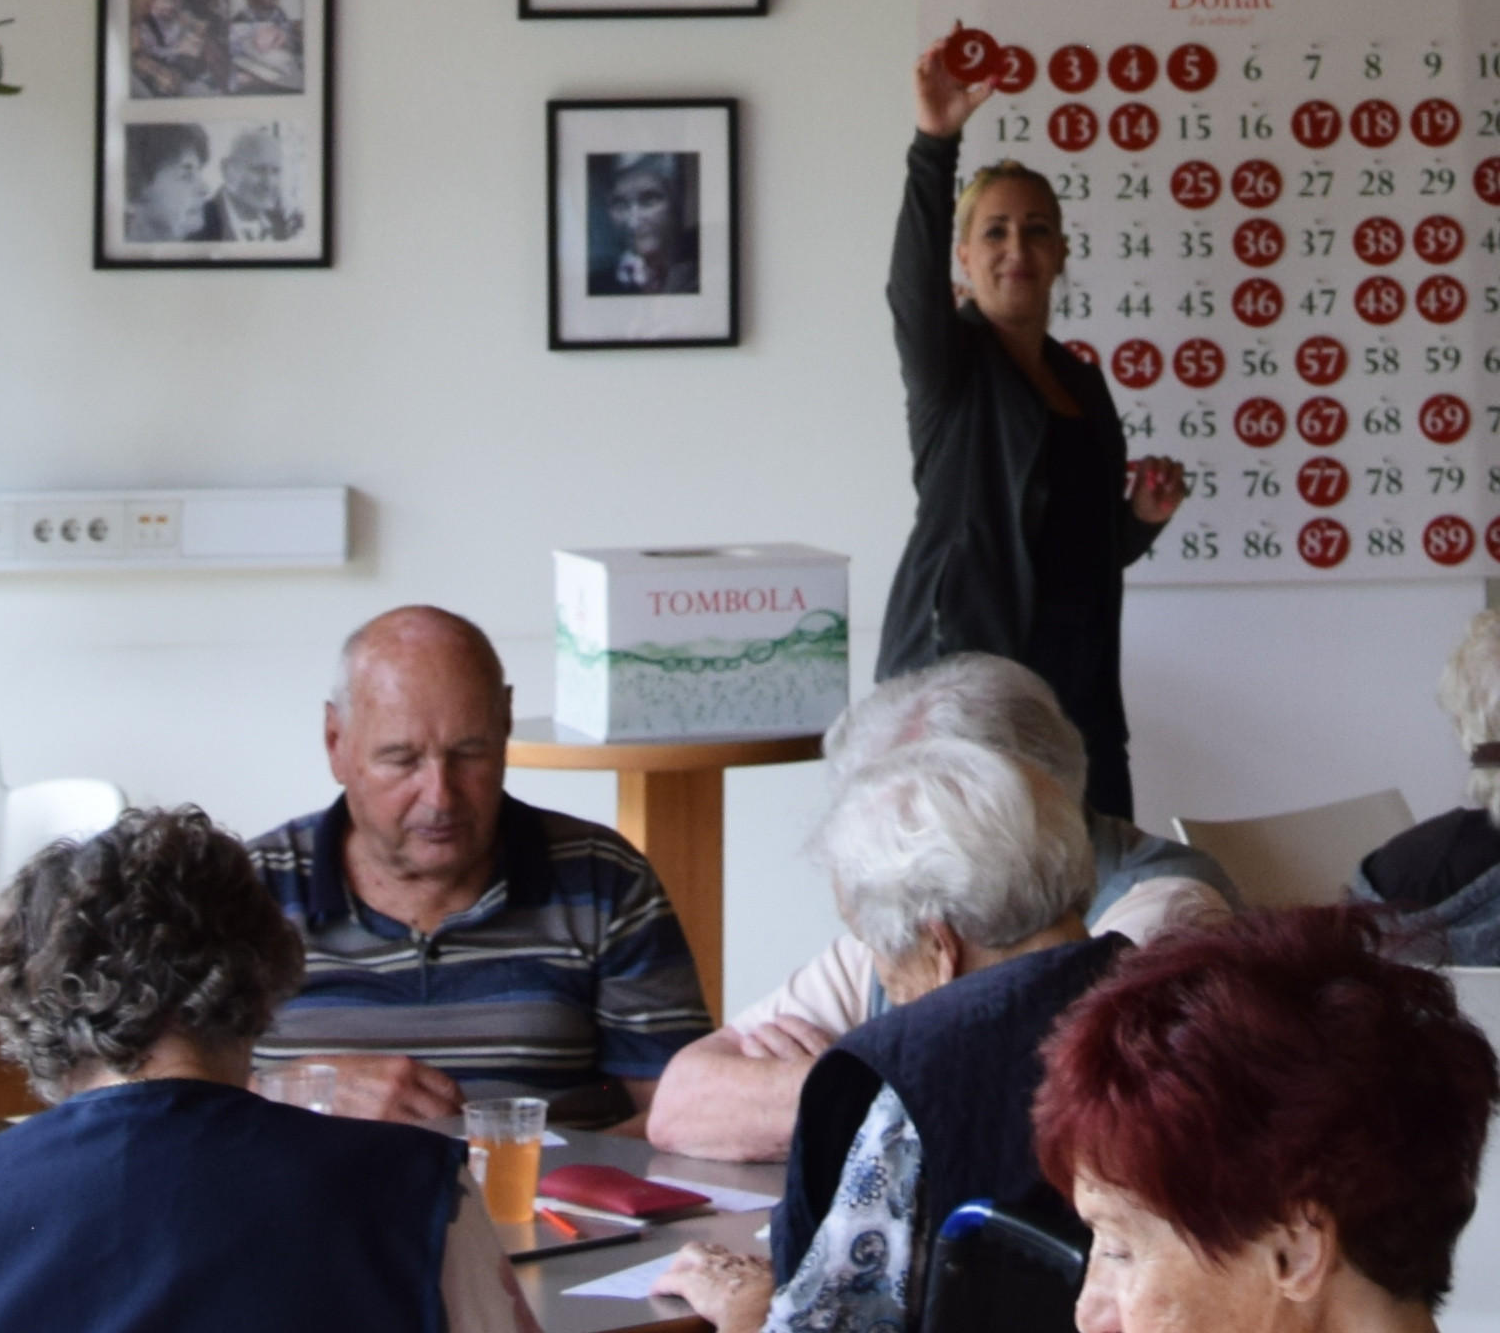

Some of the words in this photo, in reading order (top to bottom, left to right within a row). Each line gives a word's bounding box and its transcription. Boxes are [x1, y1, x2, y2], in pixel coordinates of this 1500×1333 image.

[959, 39, 986, 70] 9
[1002, 56, 1021, 84] 2
[1064, 56, 1083, 83] 3
[1123, 56, 1141, 83] 4
[1185, 55, 1201, 82] 5
[1243, 55, 1262, 81] 6
[1304, 54, 1322, 81] 7
[1365, 53, 1382, 79] 8
[1423, 52, 1443, 77] 9
[998, 115, 1030, 142] 12
[1057, 114, 1091, 142] 13
[1118, 114, 1152, 141] 14
[1179, 113, 1212, 140] 15
[1239, 114, 1274, 139] 16
[1300, 112, 1334, 139] 17
[1360, 110, 1394, 138] 18
[1420, 109, 1455, 137] 19
[1056, 173, 1092, 201] 23
[1117, 172, 1152, 200] 24
[1178, 170, 1214, 200] 25
[1241, 170, 1276, 198] 26
[1298, 170, 1334, 197] 27
[1359, 169, 1395, 196] 28
[1419, 168, 1456, 193] 29
[1063, 233, 1091, 259] 3
[1118, 232, 1152, 259] 34
[1179, 231, 1214, 258] 35
[1242, 230, 1278, 258] 36
[1300, 229, 1336, 256] 37
[1362, 228, 1397, 255] 38
[1424, 226, 1458, 254] 39
[1056, 291, 1093, 319] 43
[1117, 293, 1153, 318] 44
[1178, 290, 1215, 318] 45
[1238, 290, 1277, 316] 46
[1299, 288, 1337, 316] 47
[1360, 287, 1399, 314] 48
[1421, 286, 1460, 314] 49
[1120, 350, 1155, 379] 54
[1181, 349, 1217, 378] 55
[1243, 349, 1279, 377] 56
[1303, 346, 1339, 376] 57
[1365, 348, 1400, 374] 58
[1426, 346, 1462, 373] 59
[1179, 410, 1217, 438] 65
[1239, 410, 1279, 436] 66
[1301, 407, 1341, 436] 67
[1363, 408, 1402, 434] 68
[1423, 406, 1464, 433] 69
[1184, 470, 1218, 499] 75
[1243, 470, 1281, 498] 76
[1303, 467, 1342, 497] 77
[1365, 468, 1403, 495] 78
[1427, 466, 1466, 494] 79
[1182, 534, 1219, 559] 85
[1244, 531, 1282, 558] 86
[1303, 529, 1342, 558] 87
[1367, 531, 1404, 556] 88
[1429, 527, 1468, 554] 89
[647, 586, 808, 617] TOMBOLA
